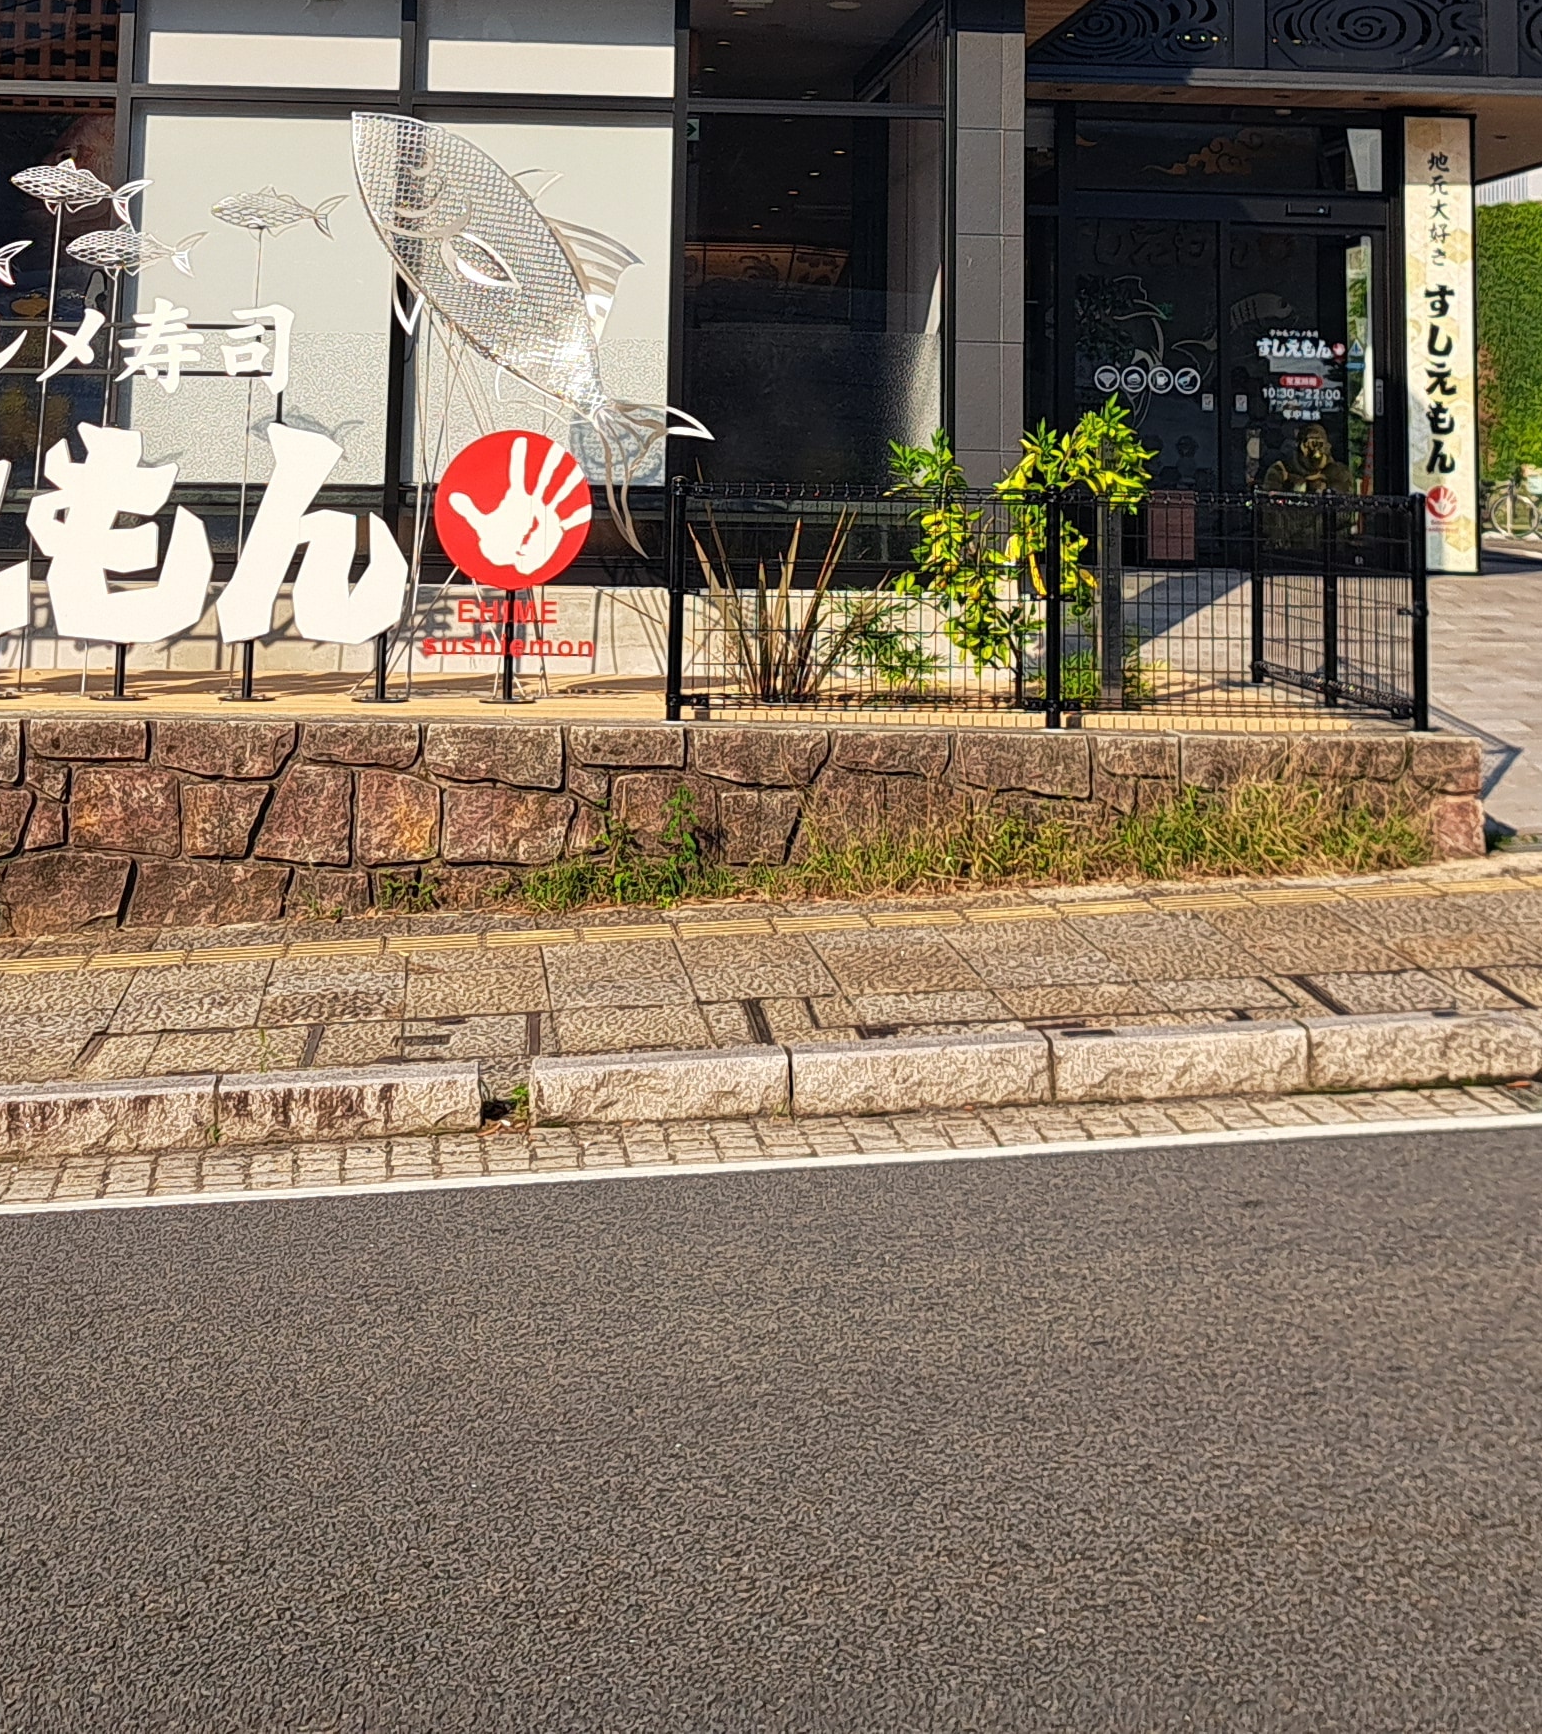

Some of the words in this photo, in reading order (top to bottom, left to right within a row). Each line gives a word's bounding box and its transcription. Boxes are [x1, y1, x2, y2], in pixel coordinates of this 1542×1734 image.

[1427, 151, 1451, 267] 地元大好き
[1256, 337, 1332, 359] すしえもん
[1424, 284, 1457, 475] すしえもん
[458, 598, 558, 624] EHIME
[422, 632, 595, 658] sushiemon
